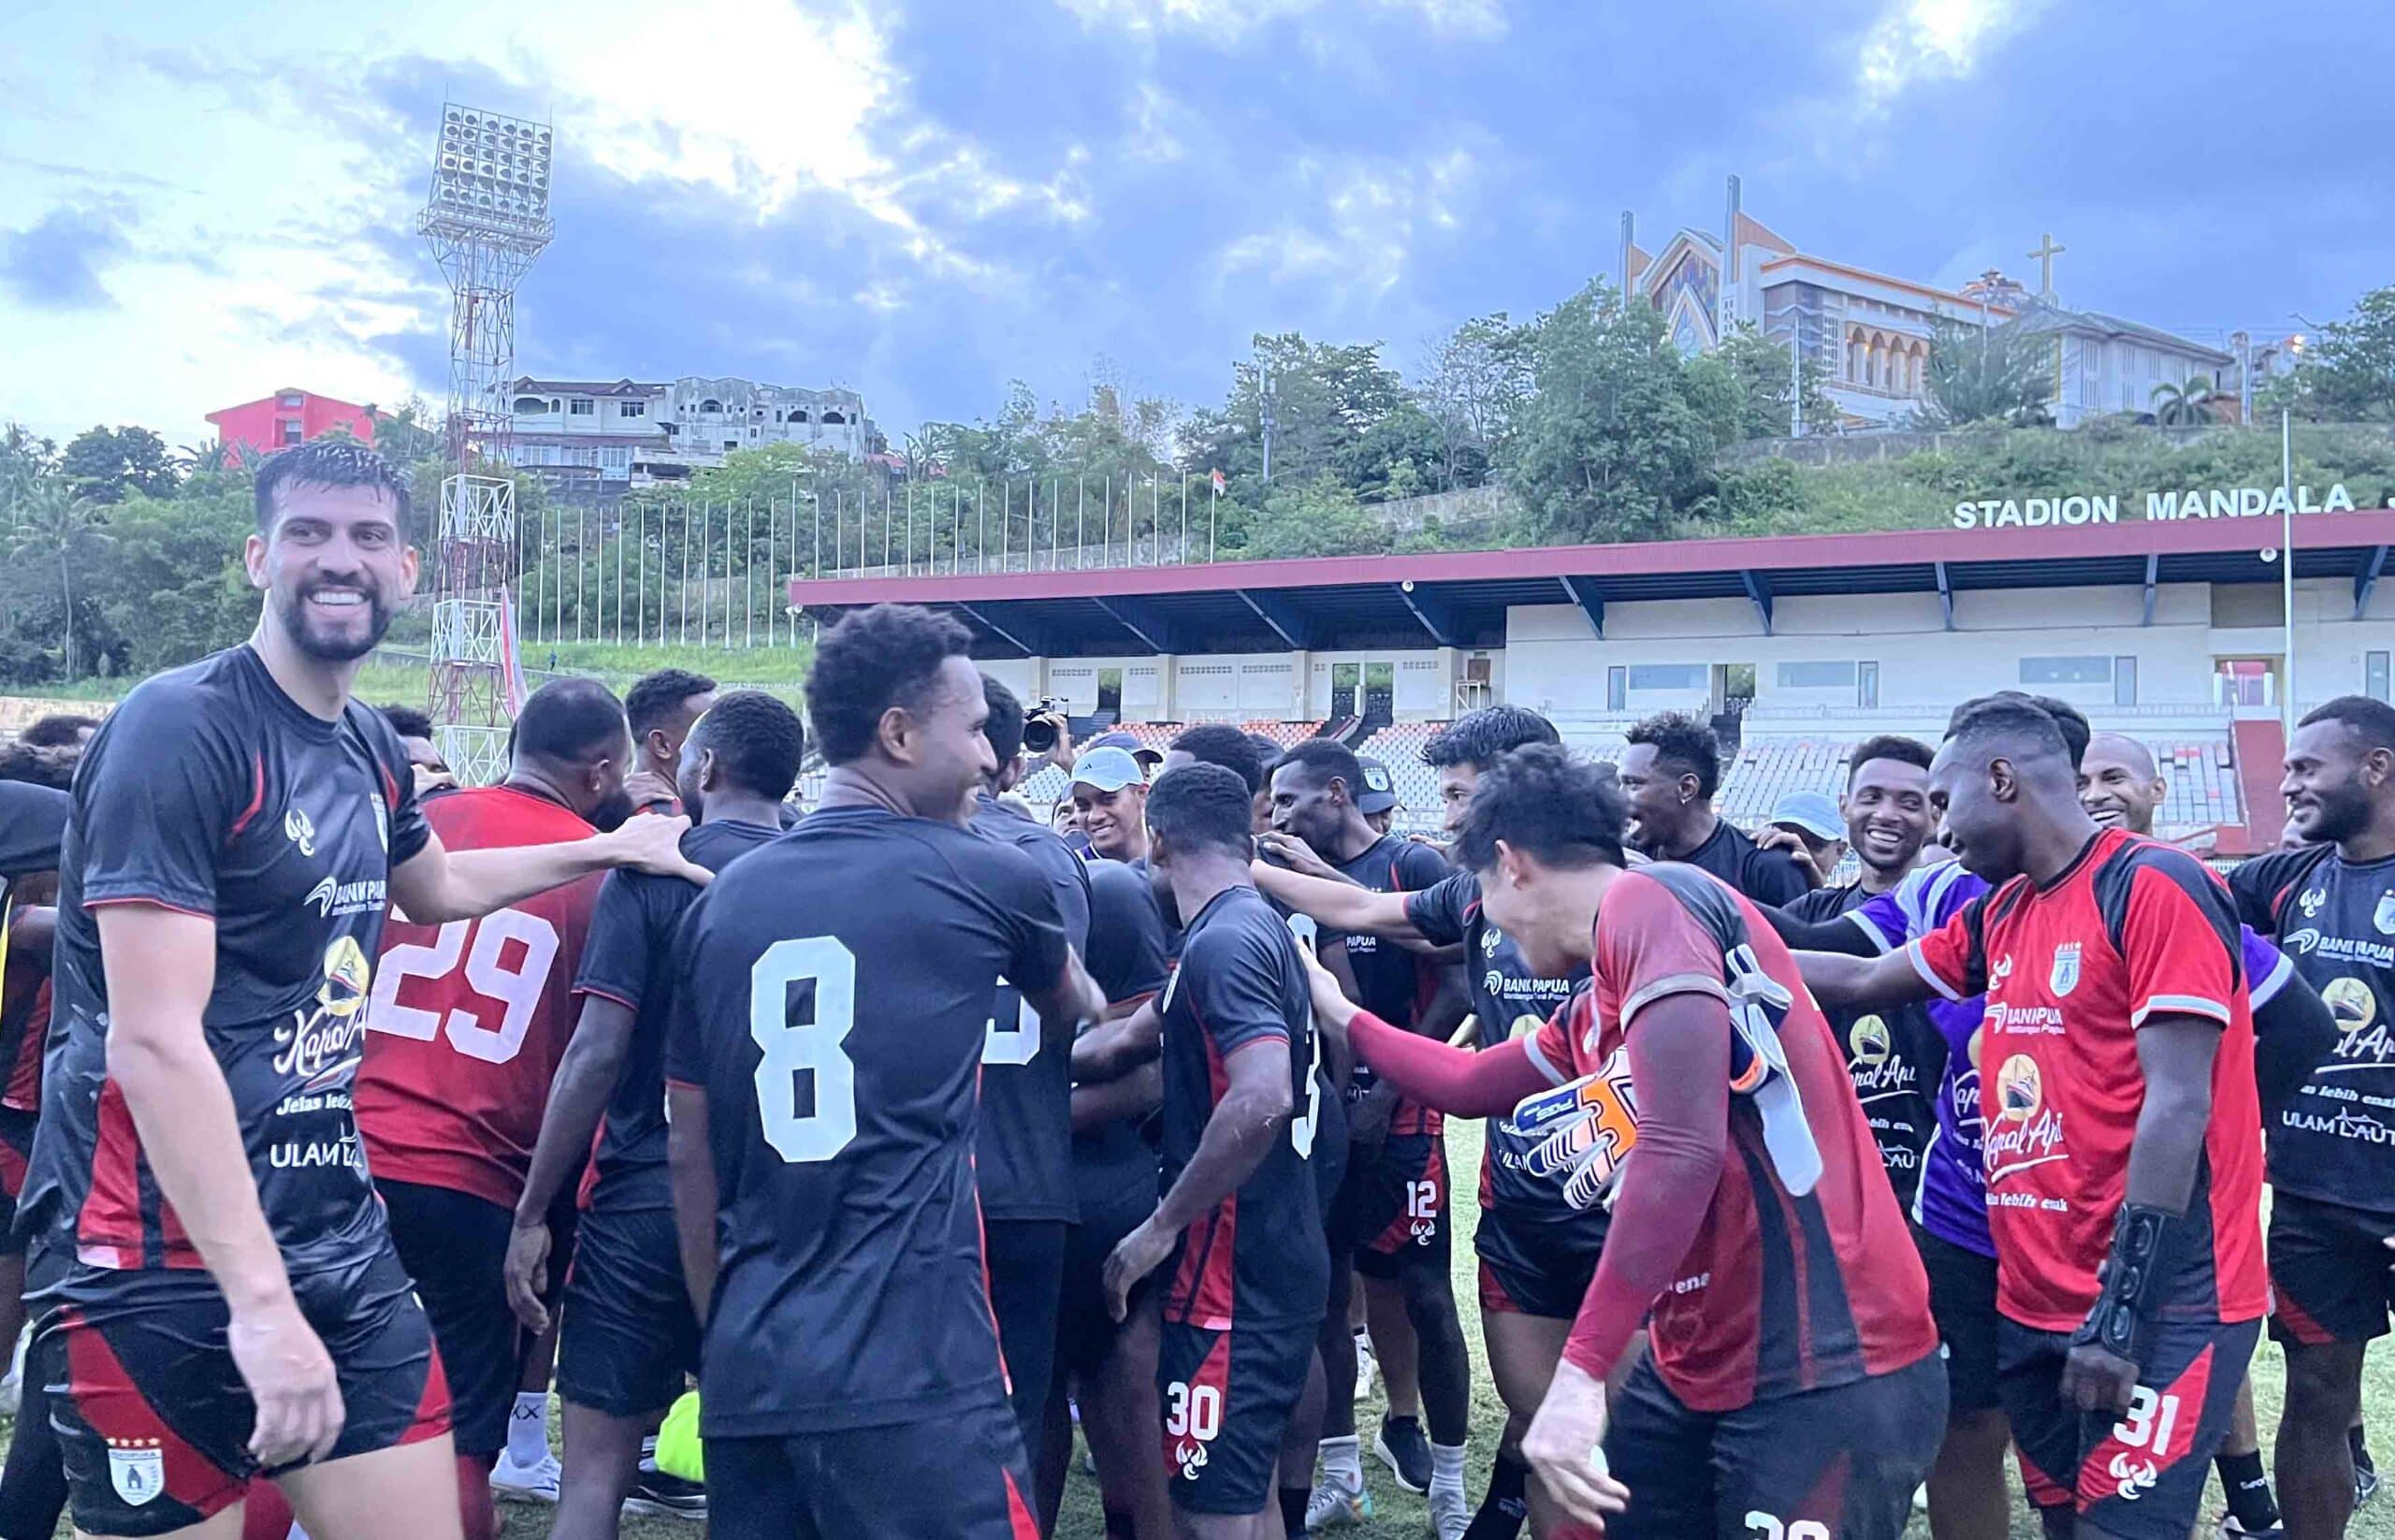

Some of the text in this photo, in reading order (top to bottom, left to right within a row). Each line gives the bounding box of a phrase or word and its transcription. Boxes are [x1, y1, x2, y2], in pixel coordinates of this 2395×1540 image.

[1952, 484, 2356, 530] STADION MANDALA
[366, 904, 559, 1065] 29
[1504, 978, 1570, 994] BANK PAPUA
[750, 935, 857, 1163] 8
[276, 1094, 322, 1115] Jelas
[2318, 1085, 2359, 1101] lebih
[2026, 1107, 2064, 1156] Api
[2282, 1110, 2335, 1134] ULAM
[269, 1142, 339, 1168] ULAM
[1406, 1180, 1437, 1218] 12
[1167, 1381, 1220, 1441] 30
[2112, 1384, 2181, 1457] 31
